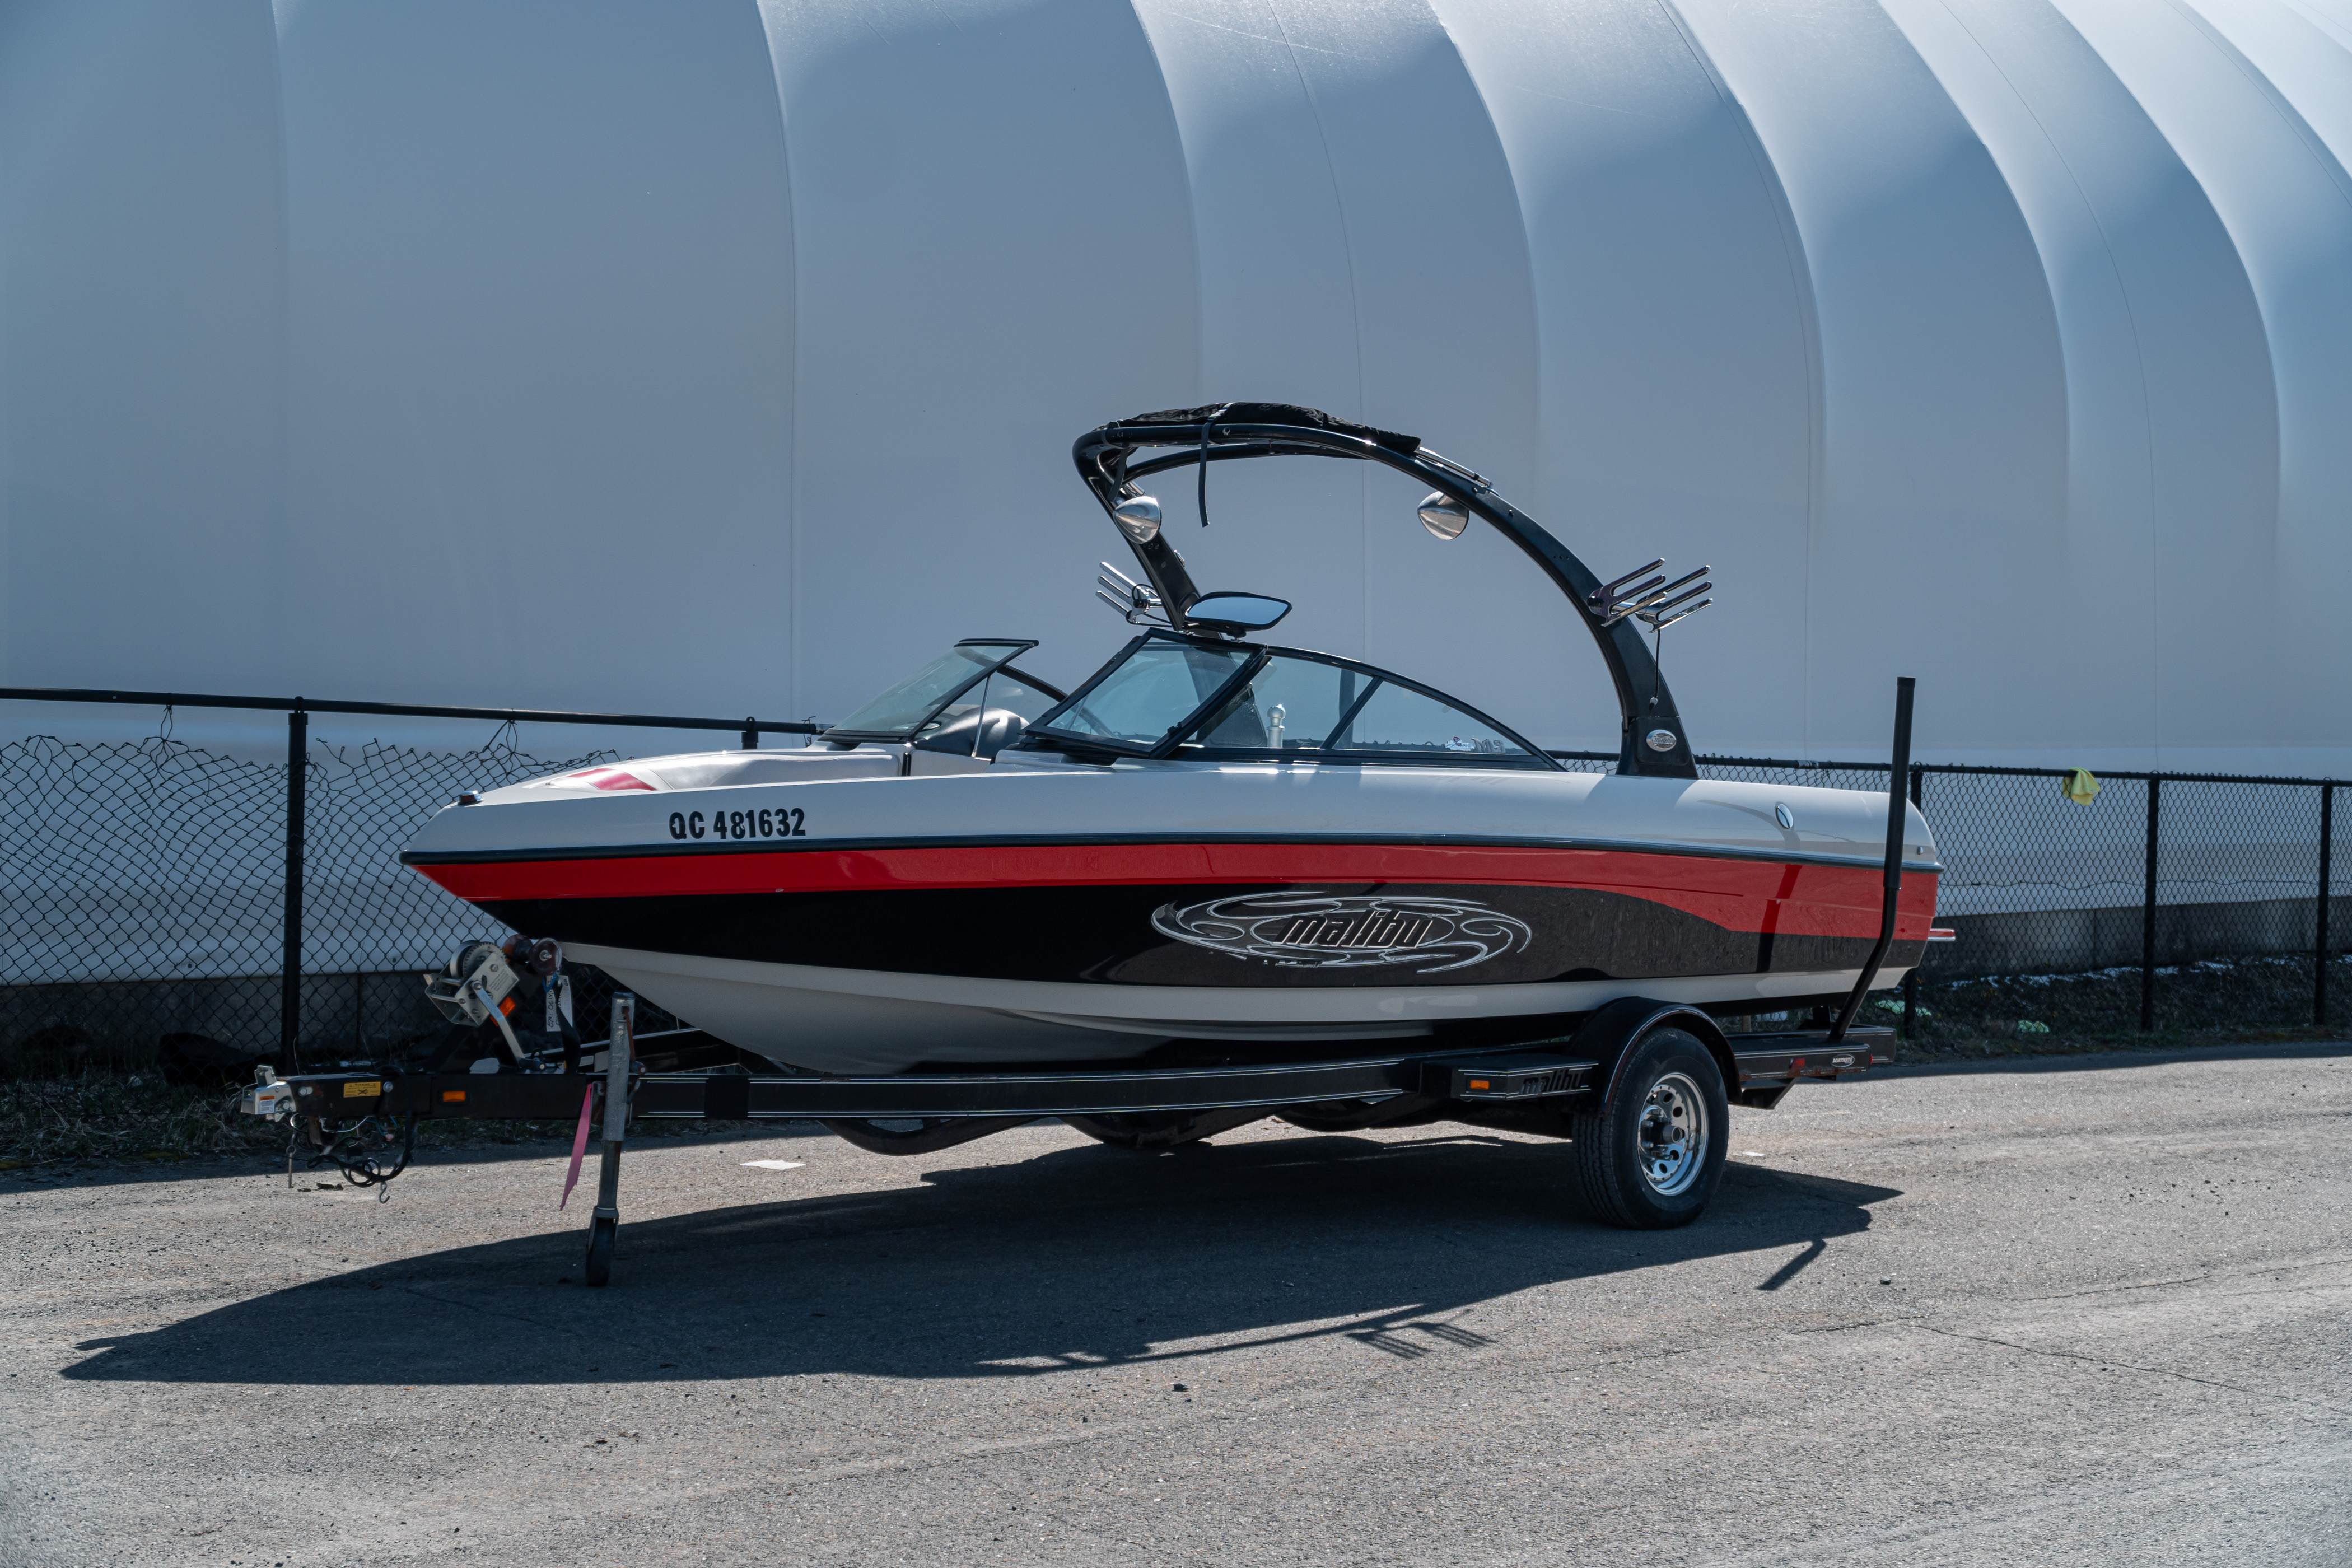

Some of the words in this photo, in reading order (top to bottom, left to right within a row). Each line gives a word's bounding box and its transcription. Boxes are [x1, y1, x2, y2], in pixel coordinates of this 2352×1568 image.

[669, 811, 705, 840] QC
[713, 808, 806, 839] 481632
[1272, 909, 1434, 948] malibu
[1519, 1068, 1585, 1094] malibu
